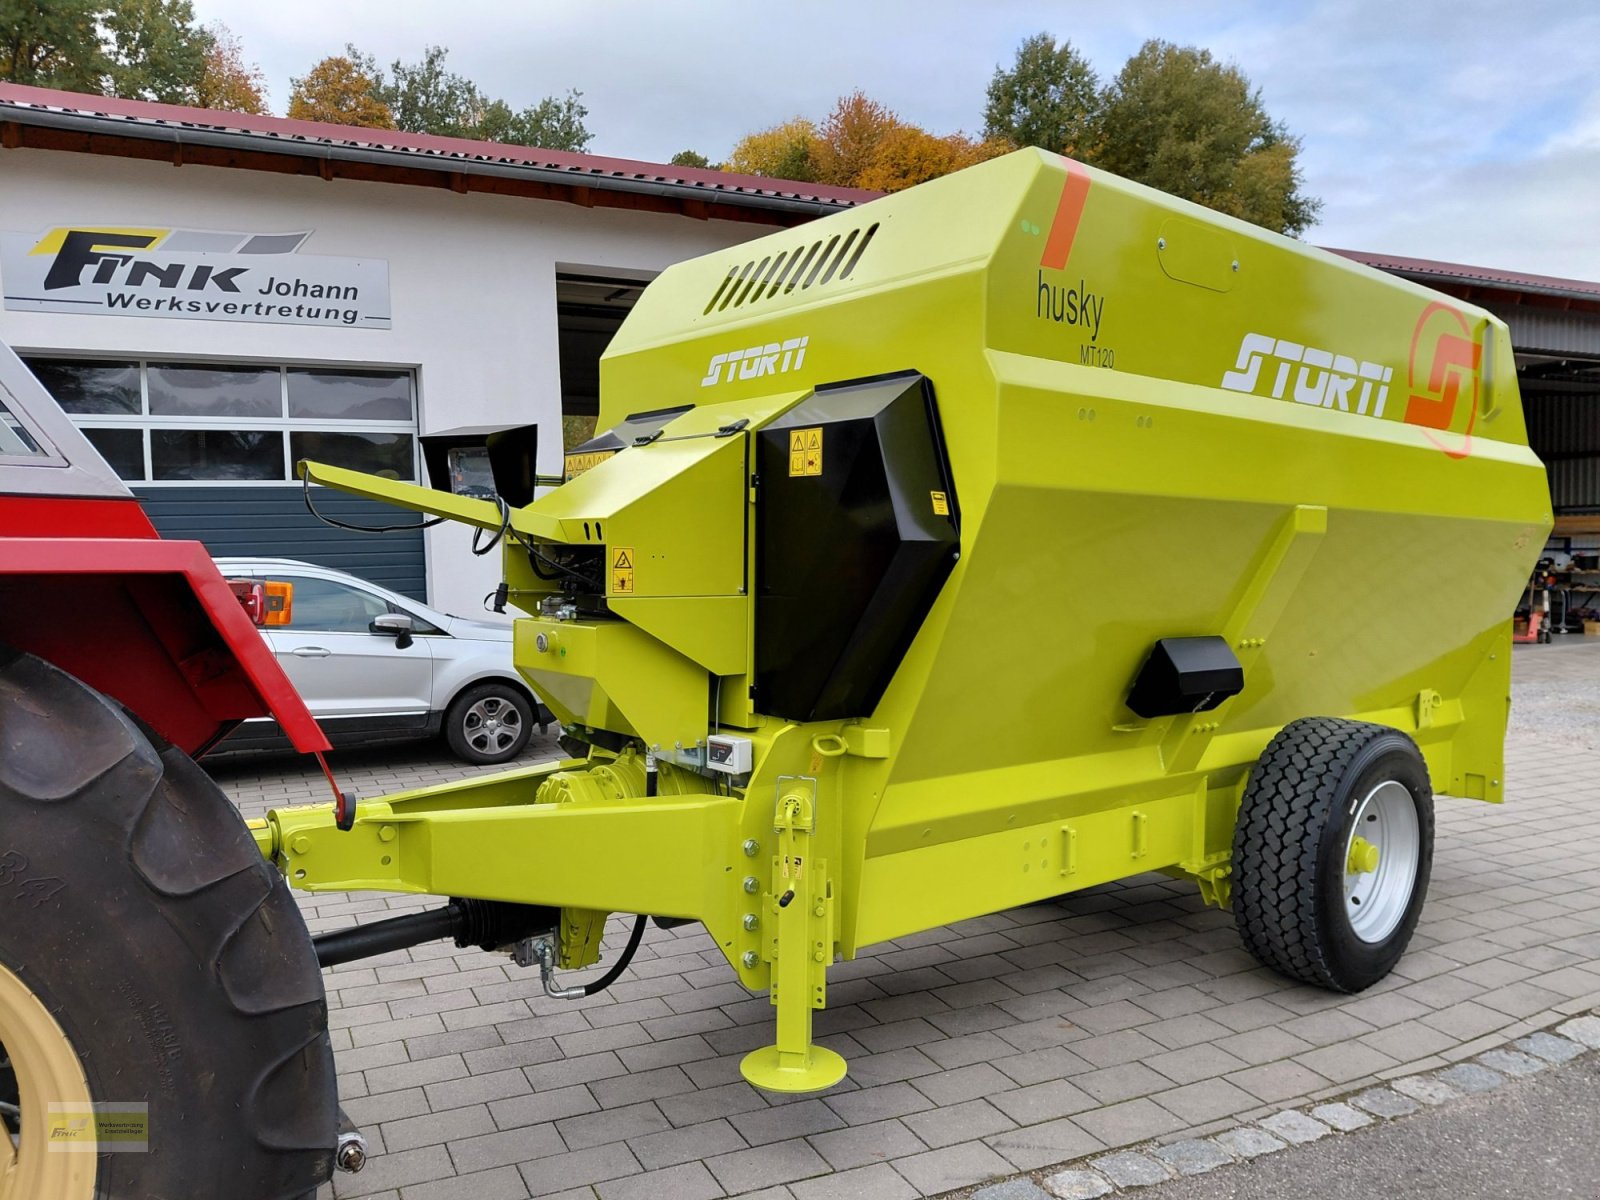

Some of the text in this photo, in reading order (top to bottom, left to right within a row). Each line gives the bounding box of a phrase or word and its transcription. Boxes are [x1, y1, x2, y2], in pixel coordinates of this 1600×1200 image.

[105, 292, 358, 324] Werksvertretung
[258, 276, 358, 301] Johann
[1037, 270, 1105, 341] husky
[701, 335, 809, 388] STORTI
[1079, 345, 1115, 369] MT120
[1221, 332, 1393, 418] STORTI
